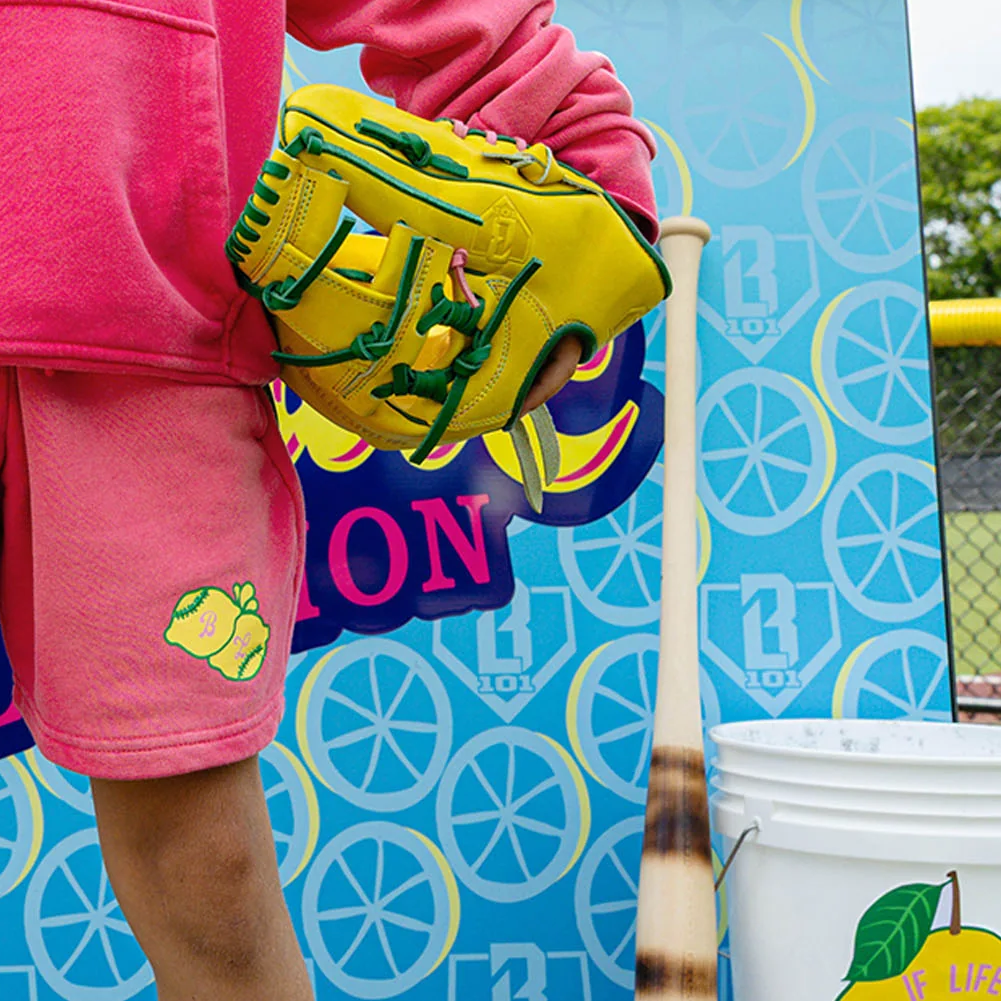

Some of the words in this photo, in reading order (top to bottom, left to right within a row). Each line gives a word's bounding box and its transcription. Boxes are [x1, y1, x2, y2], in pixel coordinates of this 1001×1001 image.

[726, 318, 780, 335] 101
[478, 674, 534, 693] 101
[745, 669, 801, 689] 101
[902, 969, 928, 1001] IF
[949, 963, 1001, 996] LIFE
